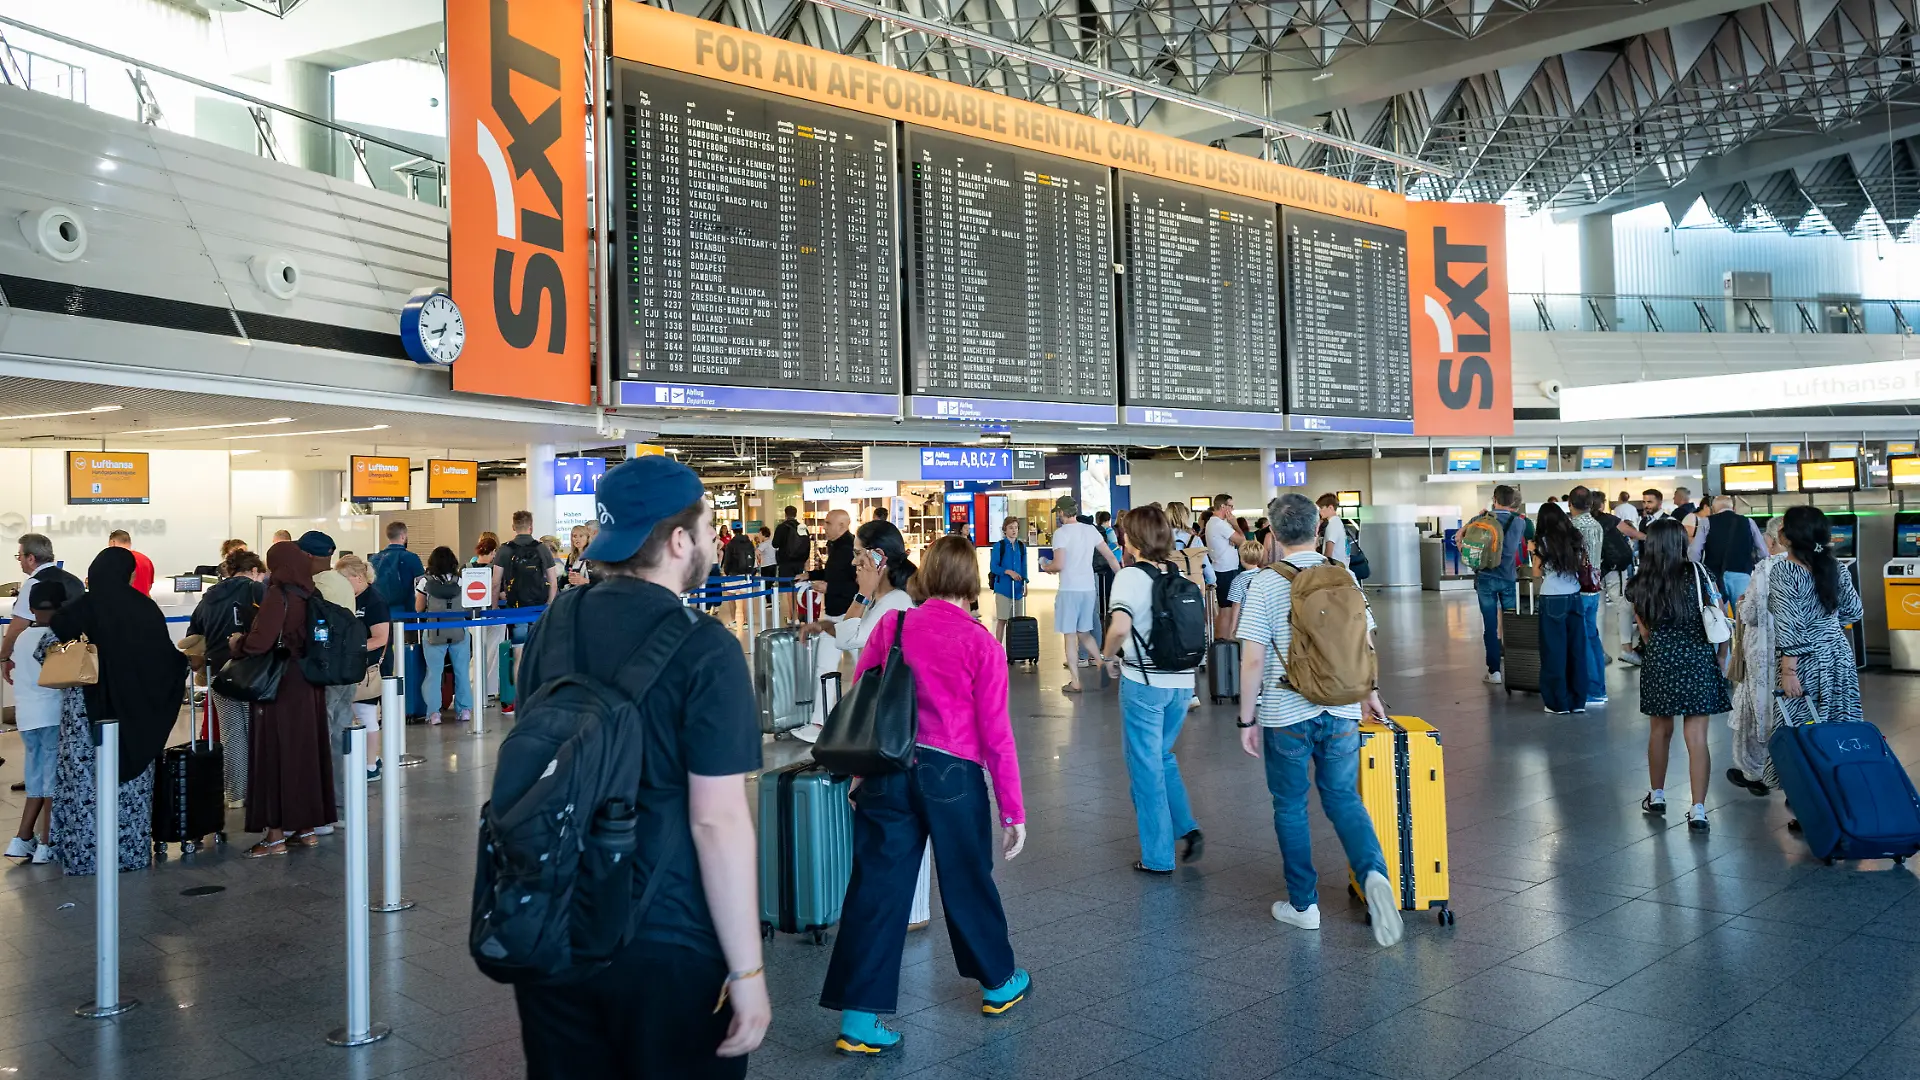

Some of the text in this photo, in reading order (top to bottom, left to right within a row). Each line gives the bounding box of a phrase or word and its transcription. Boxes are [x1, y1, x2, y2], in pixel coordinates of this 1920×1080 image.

[640, 109, 649, 118] LH
[695, 28, 1379, 217] FOR AN AFFORDABLE RENTAL CAR, THE DESTINATION IS SIXT.
[641, 119, 774, 151] LH 3642 HAMBURG-MUENSTER-OSN
[641, 129, 650, 139] LH
[687, 138, 727, 153] GOETEBORG
[641, 140, 650, 149] SQ
[688, 148, 701, 158] NEW
[641, 150, 774, 181] LH 3450 MUENCHEN-WUERZBURG-N
[641, 161, 766, 189] LH 178 BERLIN-BRANDENBURG
[642, 171, 728, 193] EN 8750 LUXEMBURG
[642, 182, 767, 208] LH 324 VENEDIG-MARCO POLO
[642, 192, 651, 201] LH
[689, 199, 715, 211] KRAKAU
[642, 202, 720, 221] LX 1069 ZUERICH
[643, 223, 652, 232] LH
[662, 226, 680, 236] 3404
[689, 230, 776, 249] MUENCHEN-STUTTGART-U
[643, 234, 652, 243] LH
[690, 240, 725, 252] ISTANBUL
[643, 245, 725, 262] LH 1544 SARAJEVO
[643, 255, 726, 272] DE 4465 BUDAPEST
[644, 266, 721, 282] LH 010 HAMBURG
[644, 276, 765, 297] LH 1156 PALMA DE MALLORCA
[644, 287, 653, 296] LH
[663, 289, 682, 298] 3730
[644, 298, 653, 306] DE
[664, 299, 682, 309] 4237
[753, 308, 769, 317] POLO
[644, 308, 753, 325] EJU 5404 MAILAND-LINATE
[1424, 226, 1494, 410] SIXT
[645, 319, 727, 333] LH 1336 BUDAPEST
[645, 329, 770, 347] LH 3604 DORTMUND-KOELN HBF
[645, 340, 779, 357] LH 3644 HAMBURG-MUENSTER-OSN
[645, 351, 741, 365] LH 072 DUESSELDORF
[645, 362, 655, 370] LH
[692, 364, 728, 374] MUENCHEN
[686, 388, 704, 397] Abflug
[1784, 375, 1906, 398] Lufthansa
[686, 397, 715, 406] Departures
[935, 451, 950, 459] Abflug
[935, 459, 959, 467] Departures
[960, 452, 996, 469] A,B,C,Z
[91, 460, 133, 469] Lufthansa
[368, 464, 399, 472] Lufthansa
[443, 466, 468, 475] Lufthansa
[564, 474, 582, 492] 12
[1278, 472, 1286, 484] 11
[1294, 471, 1305, 484] 11
[813, 485, 849, 495] worldshop
[952, 505, 966, 513] ATM
[46, 515, 166, 536] Lufthansa
